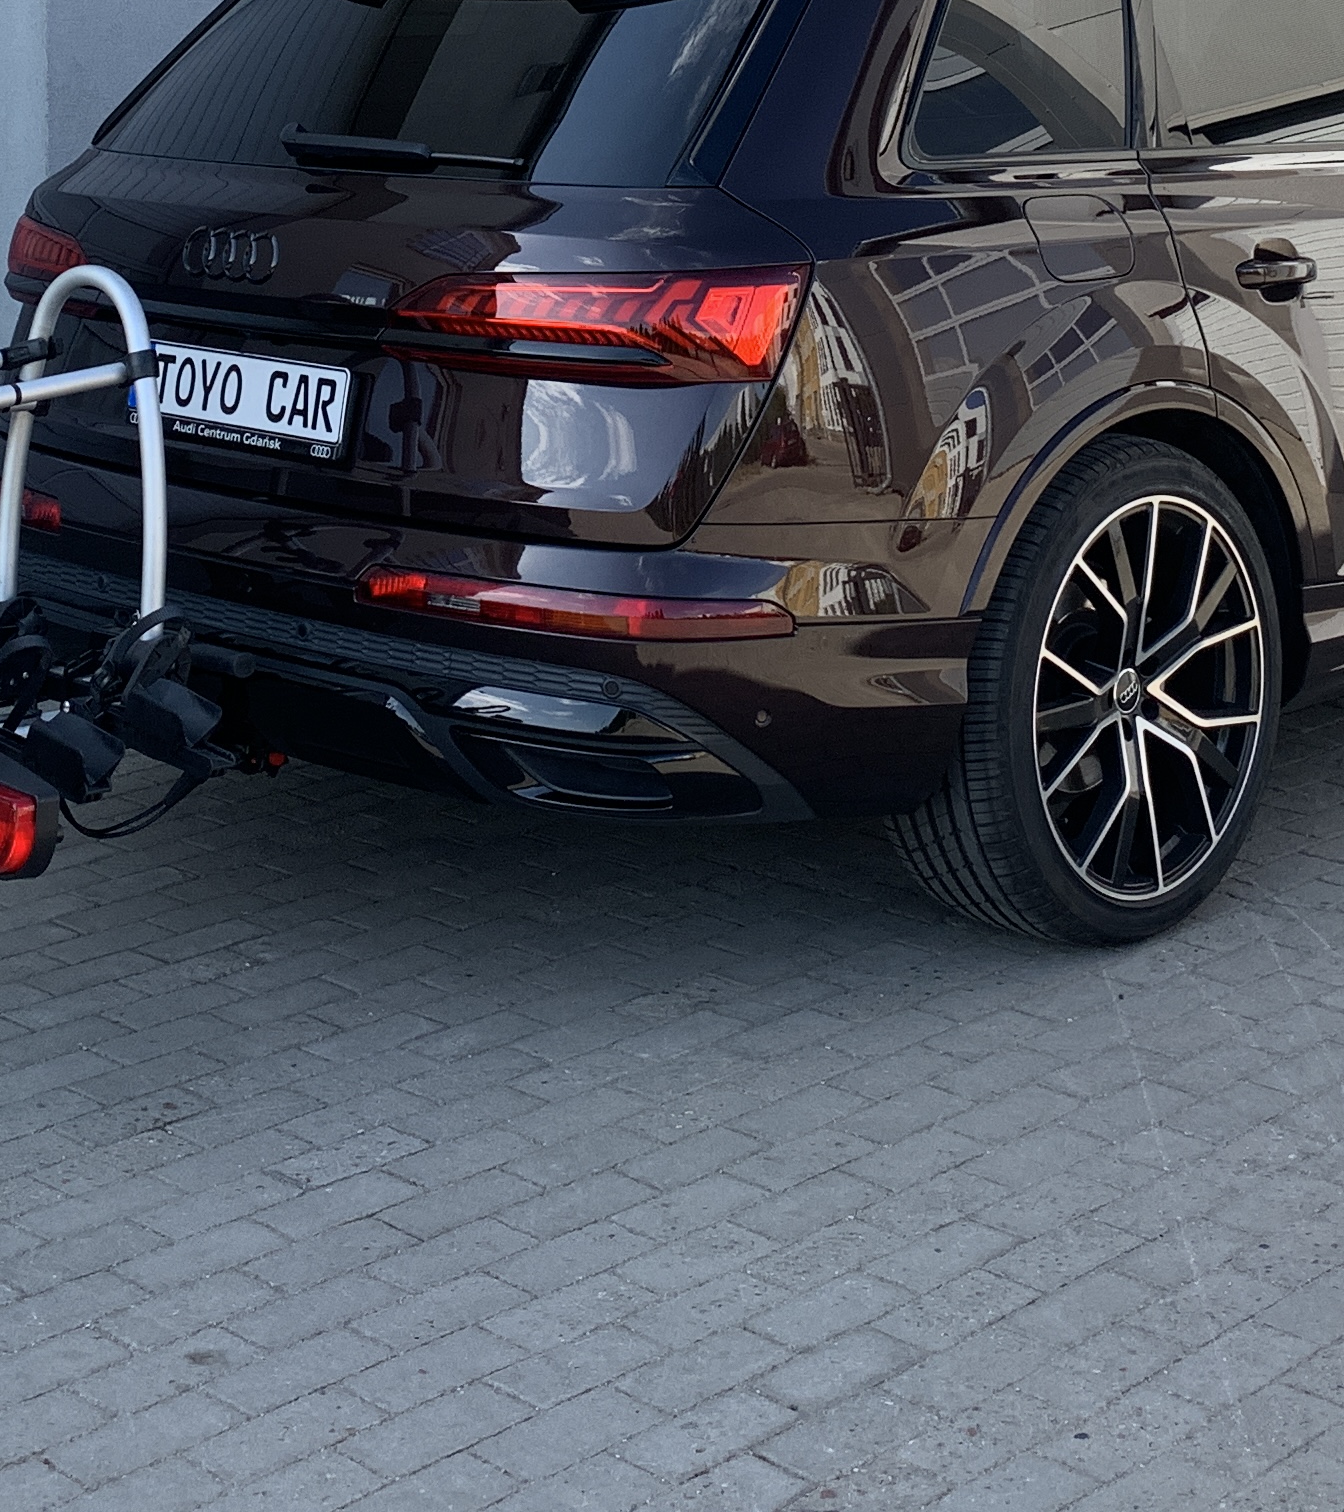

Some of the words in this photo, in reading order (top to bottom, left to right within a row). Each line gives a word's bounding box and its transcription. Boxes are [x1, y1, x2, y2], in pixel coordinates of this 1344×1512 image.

[157, 353, 243, 415] TOYO
[265, 370, 337, 433] CAR
[173, 420, 196, 434] Audi
[197, 424, 241, 443] Centrum
[243, 432, 282, 450] Gdańsk
